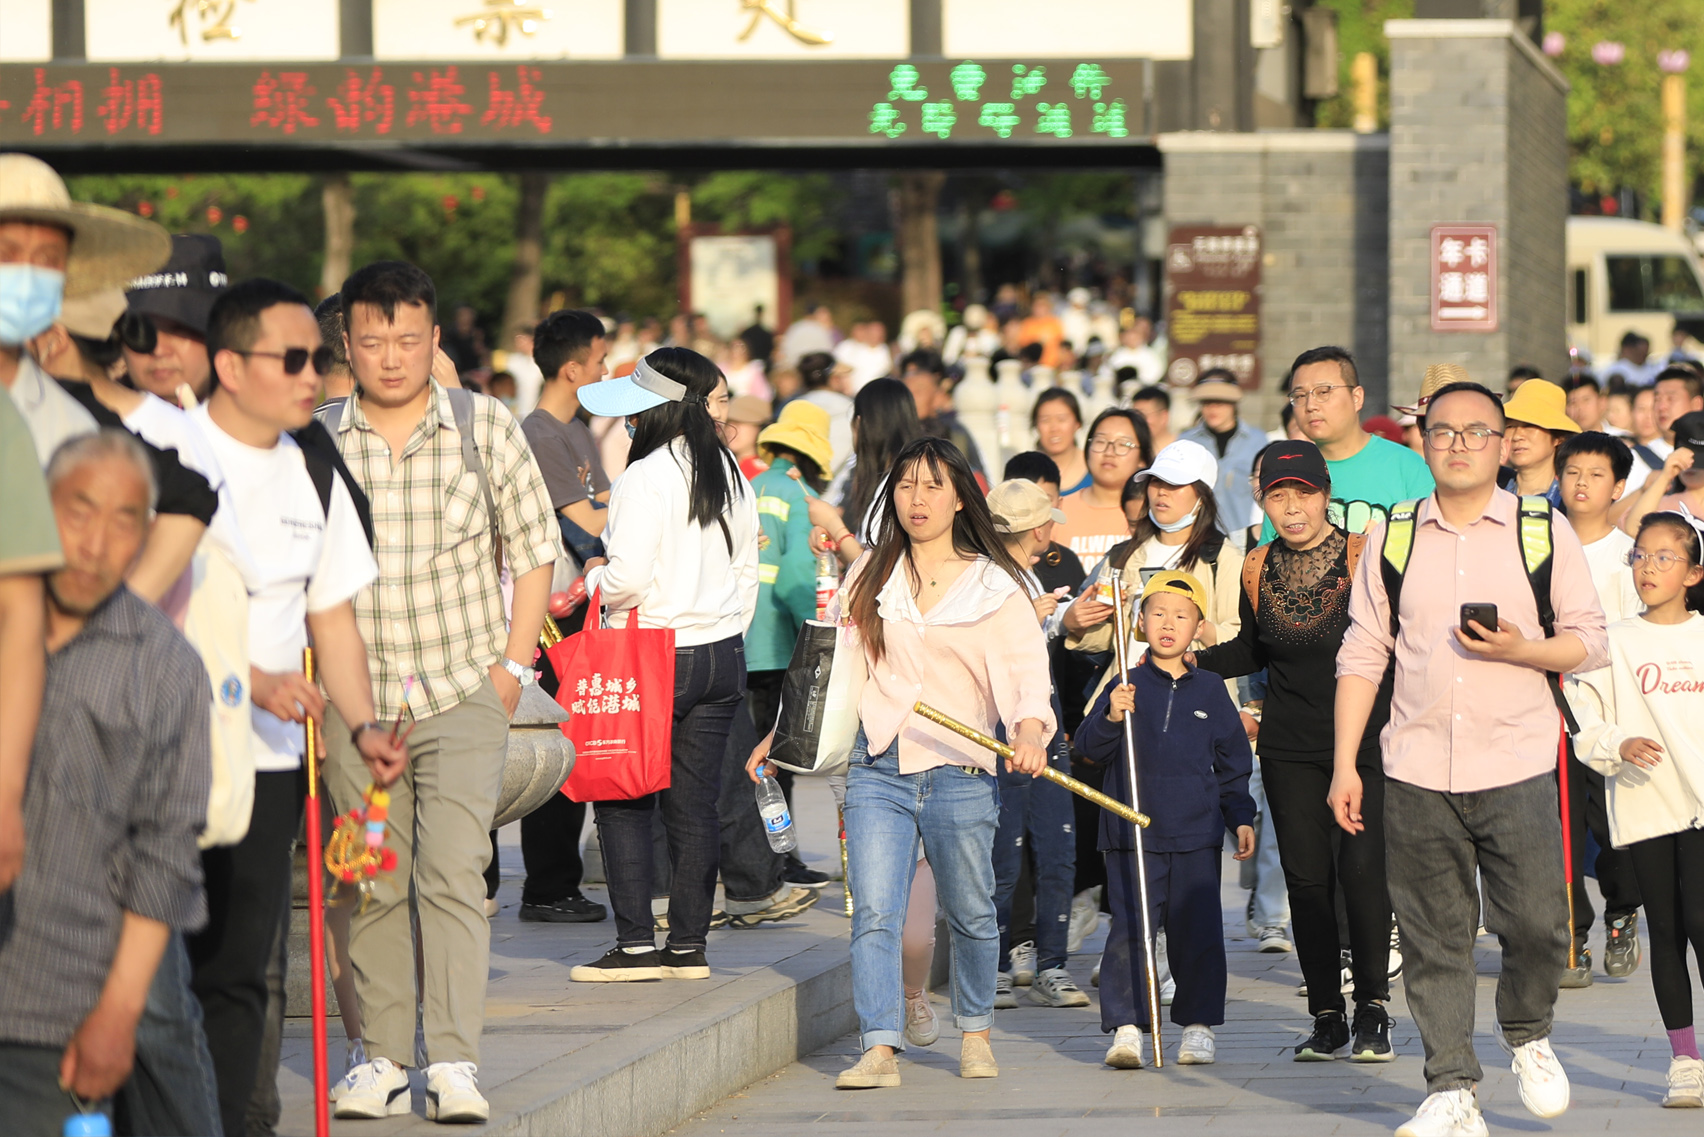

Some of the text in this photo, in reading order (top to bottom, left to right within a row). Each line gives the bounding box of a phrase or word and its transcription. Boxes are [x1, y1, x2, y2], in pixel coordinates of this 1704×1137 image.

[575, 672, 637, 696] 普惠城乡
[571, 693, 641, 715] 赋能港城
